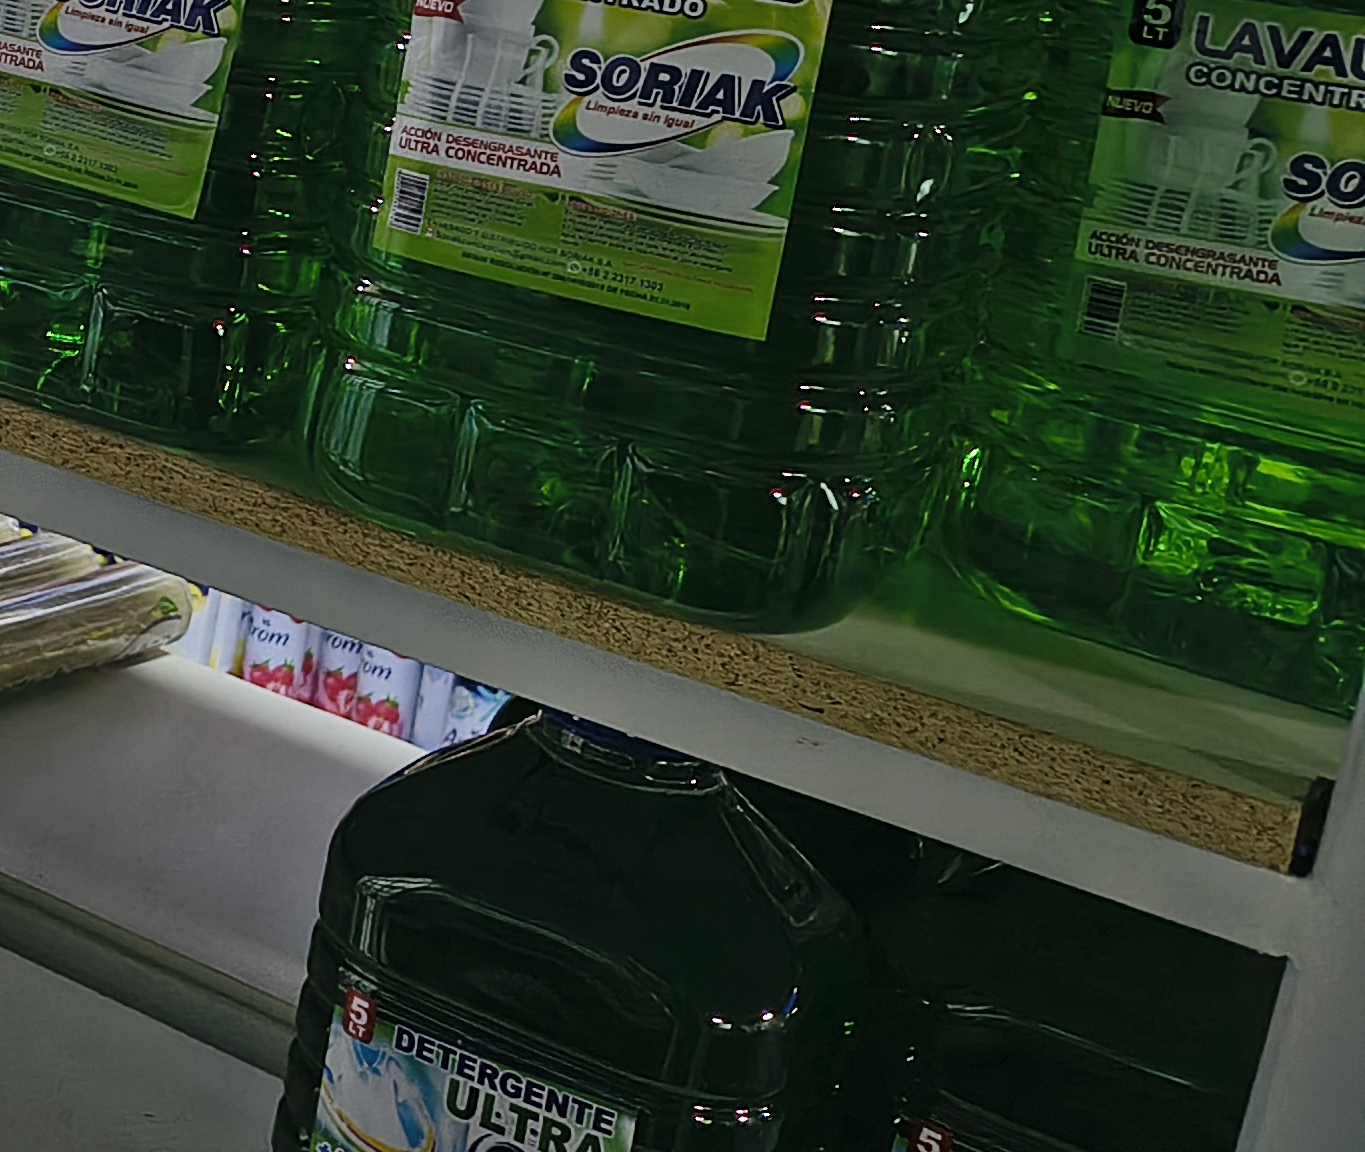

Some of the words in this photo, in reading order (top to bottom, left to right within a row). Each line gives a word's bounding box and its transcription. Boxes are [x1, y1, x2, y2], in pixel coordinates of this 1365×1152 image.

[65, 6, 106, 25] Limpieza
[108, 16, 124, 29] sin
[126, 20, 150, 36] igual
[1143, 25, 1168, 41] LT
[1194, 13, 1365, 82] LAVAL
[564, 50, 796, 128] SORIAK
[1107, 94, 1154, 115] NUEVO
[1187, 64, 1365, 110] CONCENTR
[585, 99, 639, 121] Limpieza
[641, 109, 661, 123] sin
[663, 113, 696, 130] igual
[399, 136, 440, 157] ULTRA
[445, 147, 561, 178] CONCENTRADA
[401, 125, 442, 142] ACCIÓN
[445, 134, 559, 163] DESENGRASANTE
[1088, 241, 1139, 263] ULTRA
[1145, 252, 1282, 286] CONCENTRADA
[1090, 229, 1142, 247] ACCIÓN
[1145, 239, 1279, 270] DESENGRASANTE
[348, 996, 369, 1027] 5
[349, 1022, 365, 1039] LT
[394, 1024, 618, 1138] DETERGENTE
[446, 1078, 606, 1152] ULTRA
[917, 1126, 943, 1152] 5
